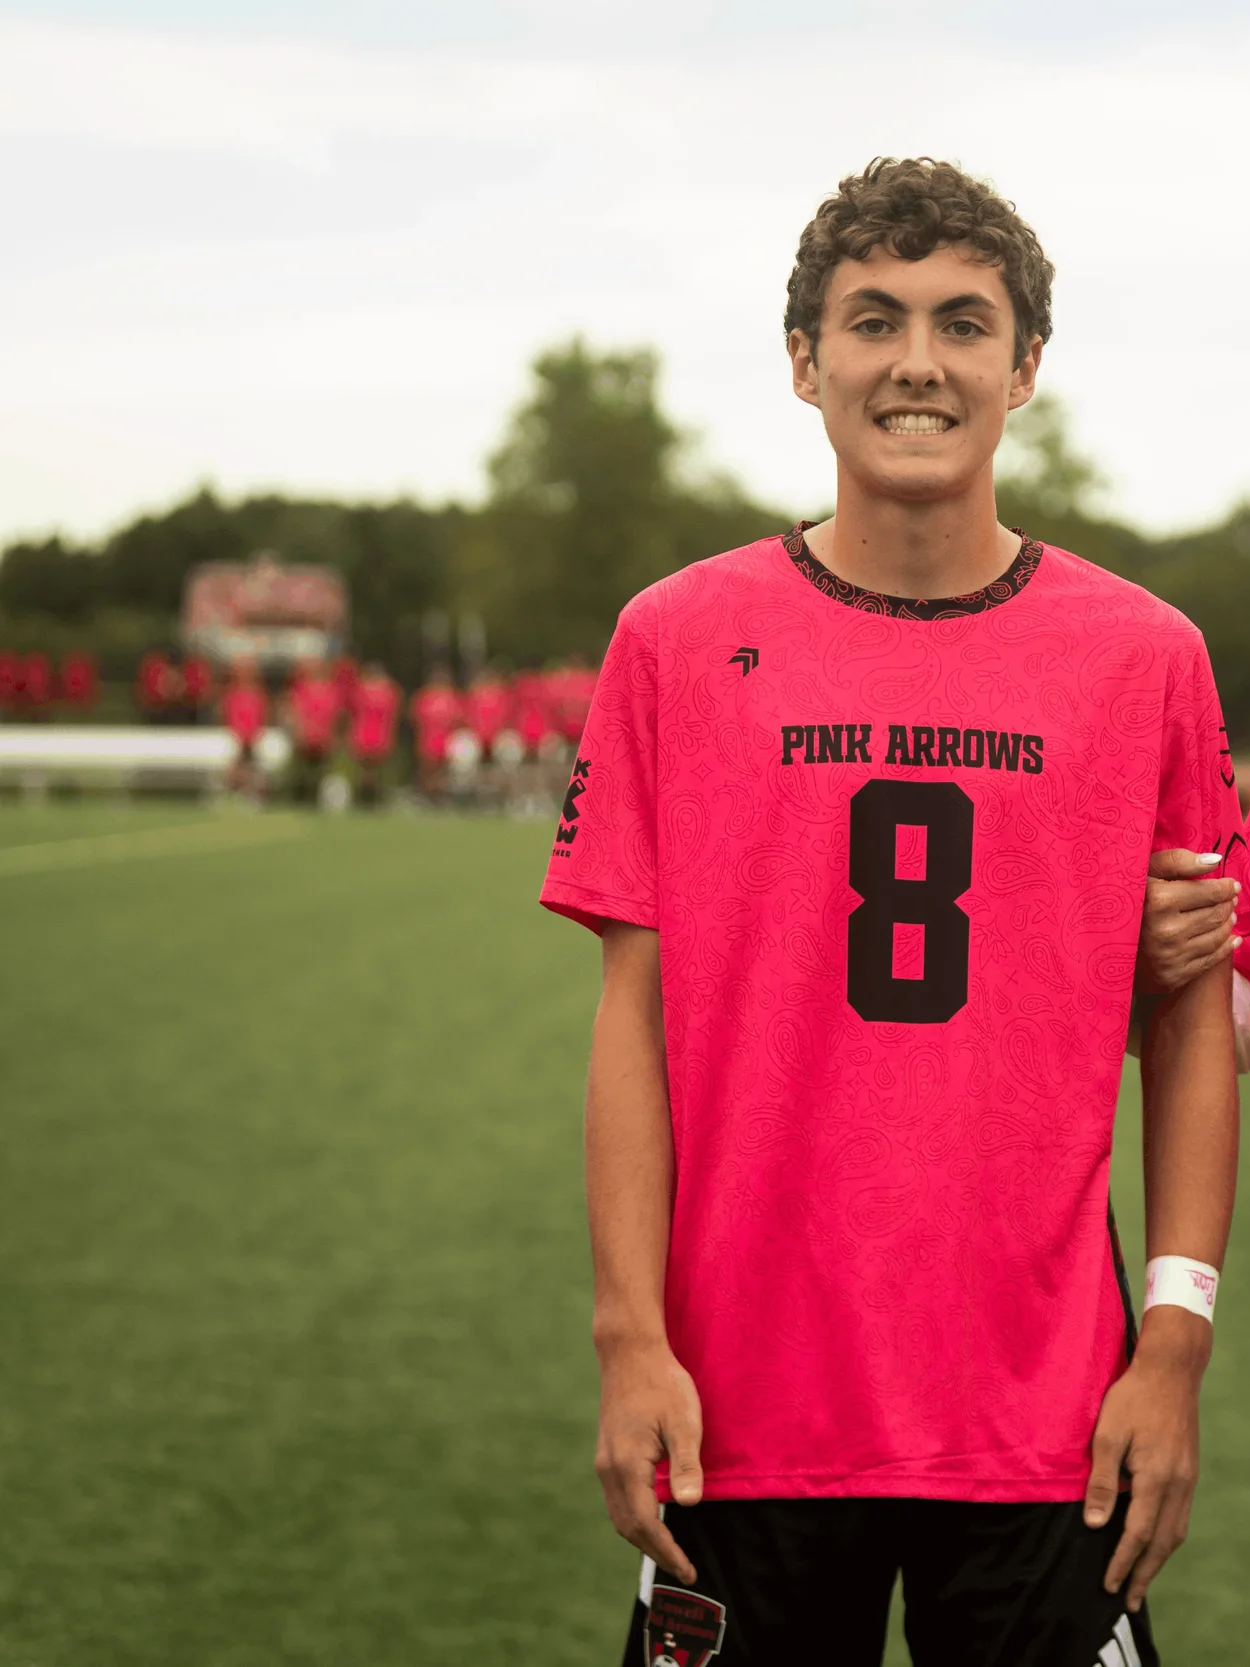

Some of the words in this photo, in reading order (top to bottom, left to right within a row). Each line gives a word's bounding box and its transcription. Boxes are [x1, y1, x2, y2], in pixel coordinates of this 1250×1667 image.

[781, 724, 872, 766] PINK
[885, 725, 1044, 774] ARROWS
[847, 778, 975, 1024] 8
